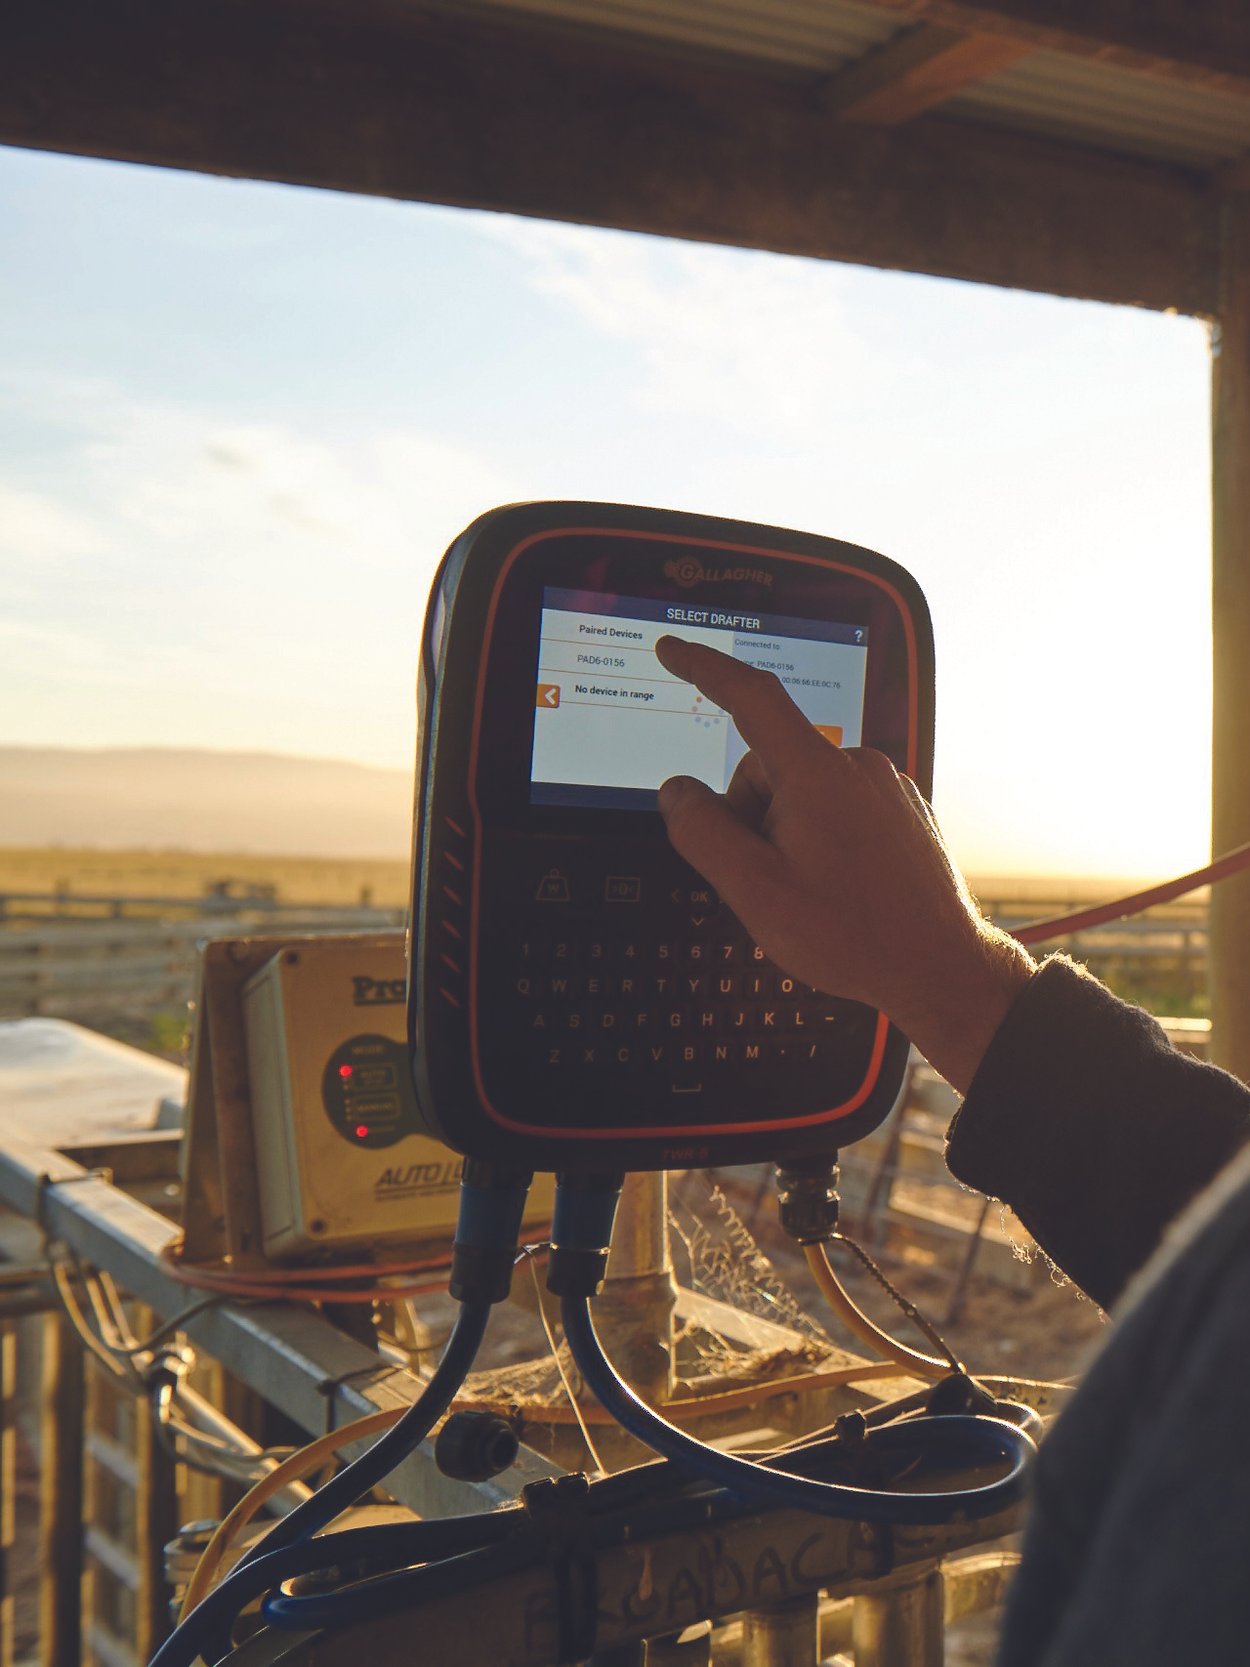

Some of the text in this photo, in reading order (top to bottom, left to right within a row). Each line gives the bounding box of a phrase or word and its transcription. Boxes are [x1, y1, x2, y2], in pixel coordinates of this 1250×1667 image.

[679, 561, 774, 588] GALLAGHER
[667, 608, 760, 630] SELECT DRAFTER
[579, 624, 642, 640] Paired Devices
[734, 638, 771, 649] Connected
[577, 654, 625, 668] PAD6-0156
[757, 660, 794, 671] PAD6-0156
[575, 685, 655, 702] No device in range
[556, 944, 567, 957] 2
[592, 944, 602, 958] 3
[625, 945, 636, 958] 4
[658, 946, 669, 958] 5
[690, 946, 702, 959] 6
[723, 946, 734, 959] 7
[517, 979, 530, 994] Q
[552, 979, 568, 993] W
[588, 979, 599, 993] E
[622, 979, 634, 993] R
[656, 979, 667, 993] T
[688, 979, 700, 993] Y
[719, 979, 733, 993] U
[533, 1014, 545, 1027] A
[569, 1014, 581, 1028] S
[602, 1014, 615, 1028] D
[637, 1013, 648, 1027] F
[669, 1013, 682, 1028] G
[702, 1013, 714, 1027] H
[735, 1012, 745, 1027] J
[764, 1011, 775, 1026] K
[795, 1011, 804, 1026] L
[549, 1049, 561, 1063] Z
[584, 1049, 595, 1062] X
[618, 1048, 630, 1062] C
[652, 1047, 663, 1061] V
[684, 1046, 695, 1060] B
[716, 1046, 727, 1060] N
[746, 1045, 760, 1059] M
[377, 1163, 441, 1186] AUTO
